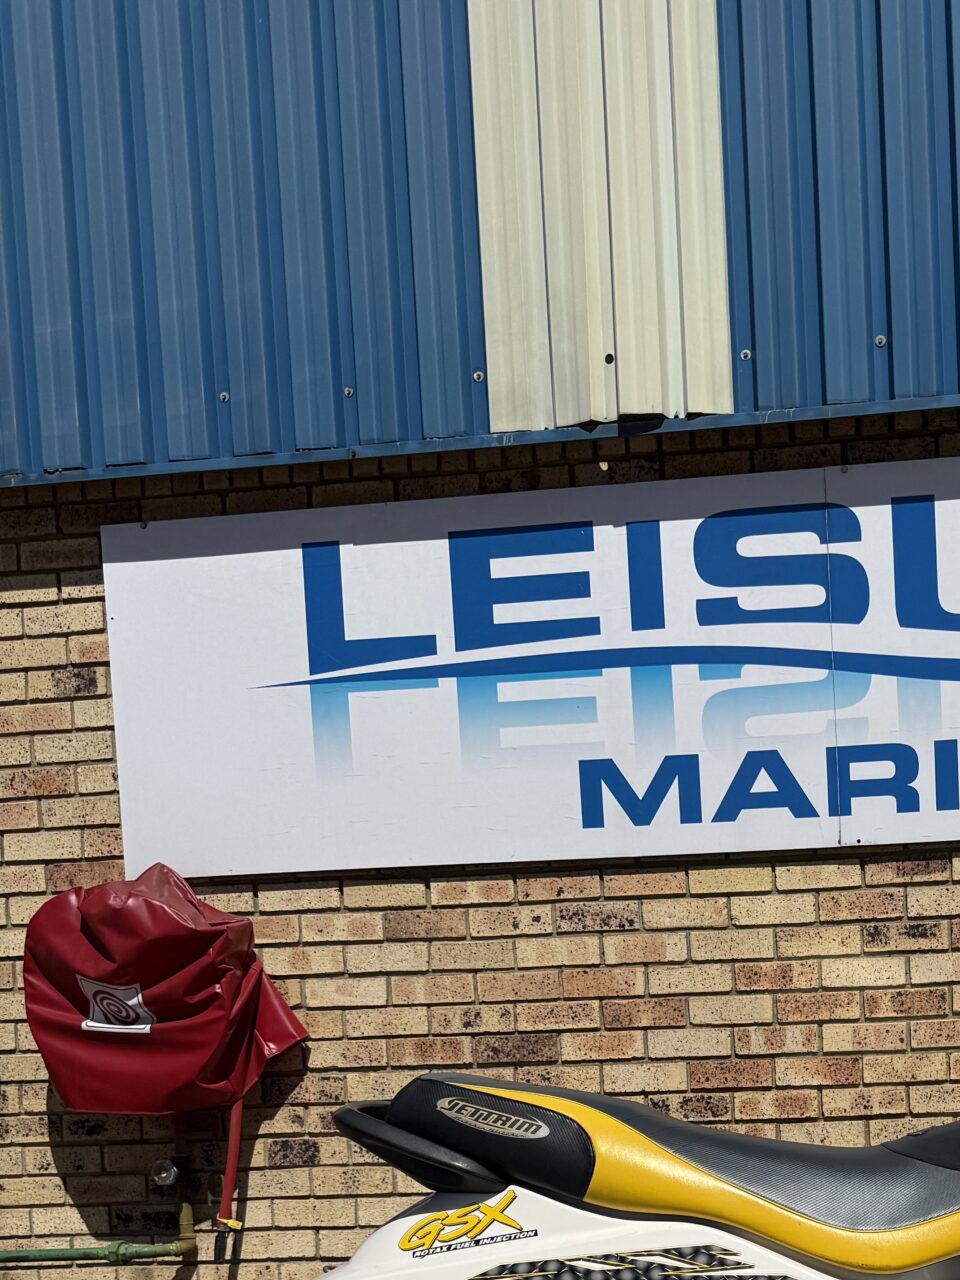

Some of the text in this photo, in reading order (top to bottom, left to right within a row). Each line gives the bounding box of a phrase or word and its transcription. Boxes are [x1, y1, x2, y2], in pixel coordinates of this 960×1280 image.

[398, 1189, 523, 1251] GSX
[413, 1230, 536, 1258] ROTAX FUEL INJECTION
